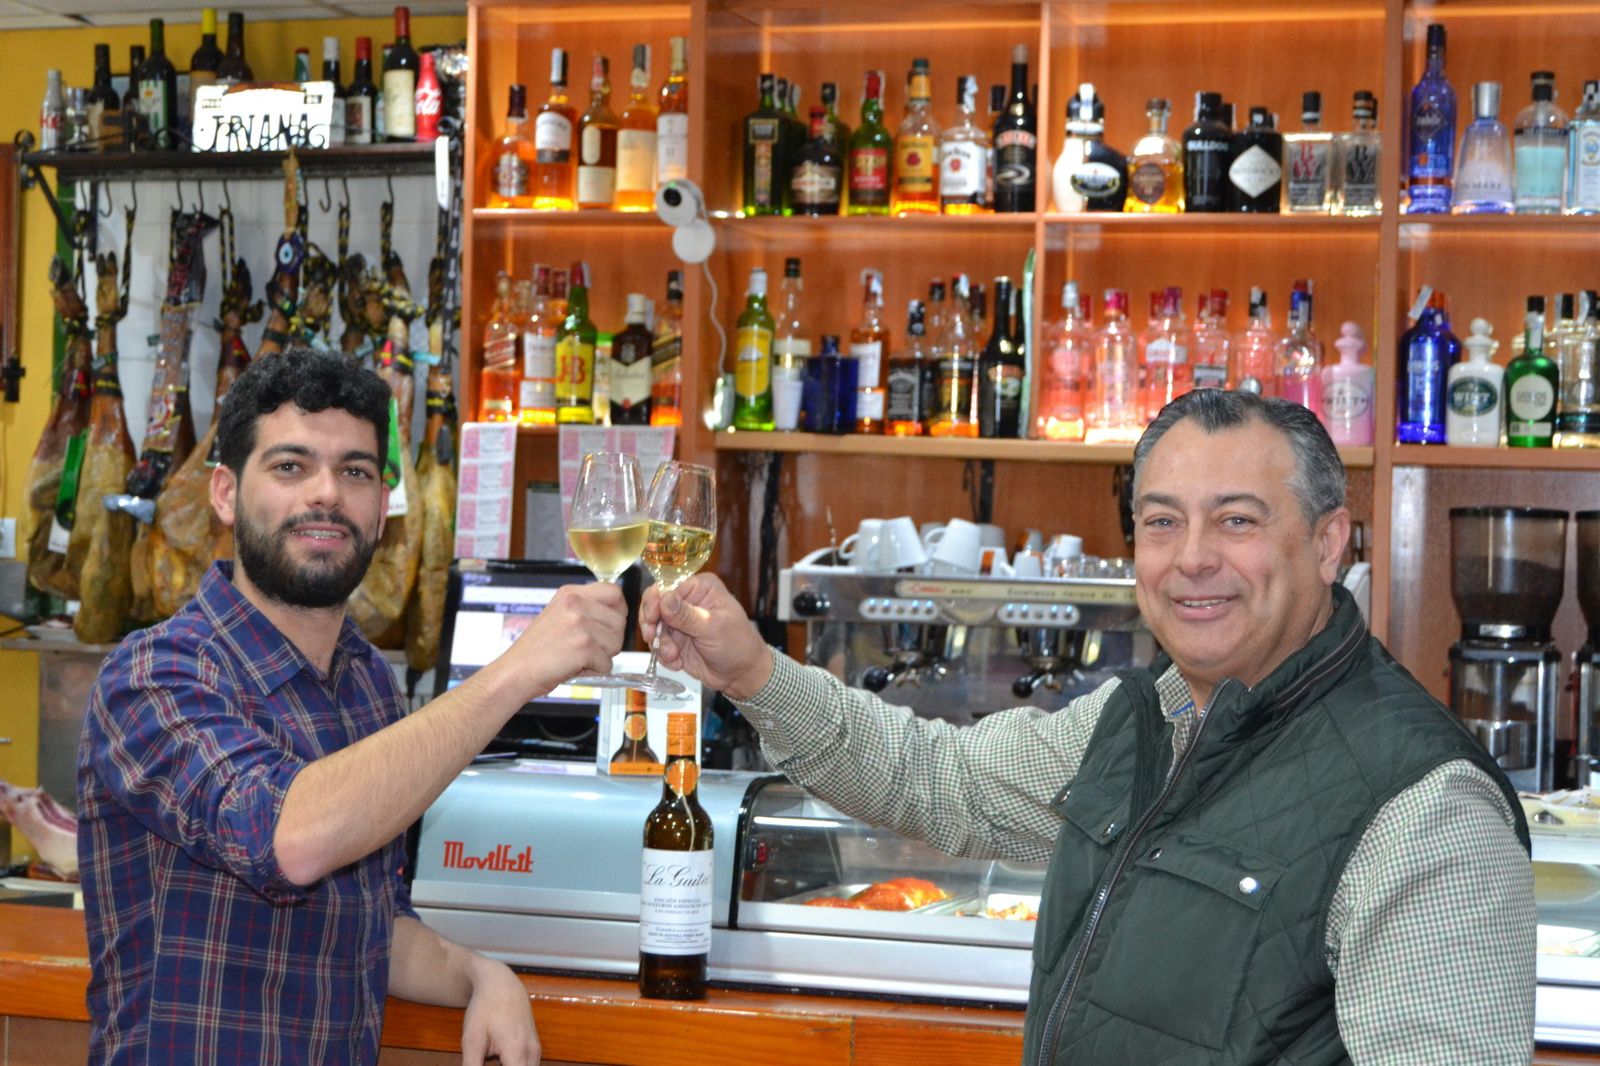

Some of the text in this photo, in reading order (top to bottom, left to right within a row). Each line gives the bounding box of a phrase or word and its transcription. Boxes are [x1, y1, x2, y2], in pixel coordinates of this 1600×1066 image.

[212, 113, 309, 151] TRIANA
[1453, 391, 1490, 403] WINT
[444, 841, 533, 873] Movilfrit
[643, 864, 666, 886] La
